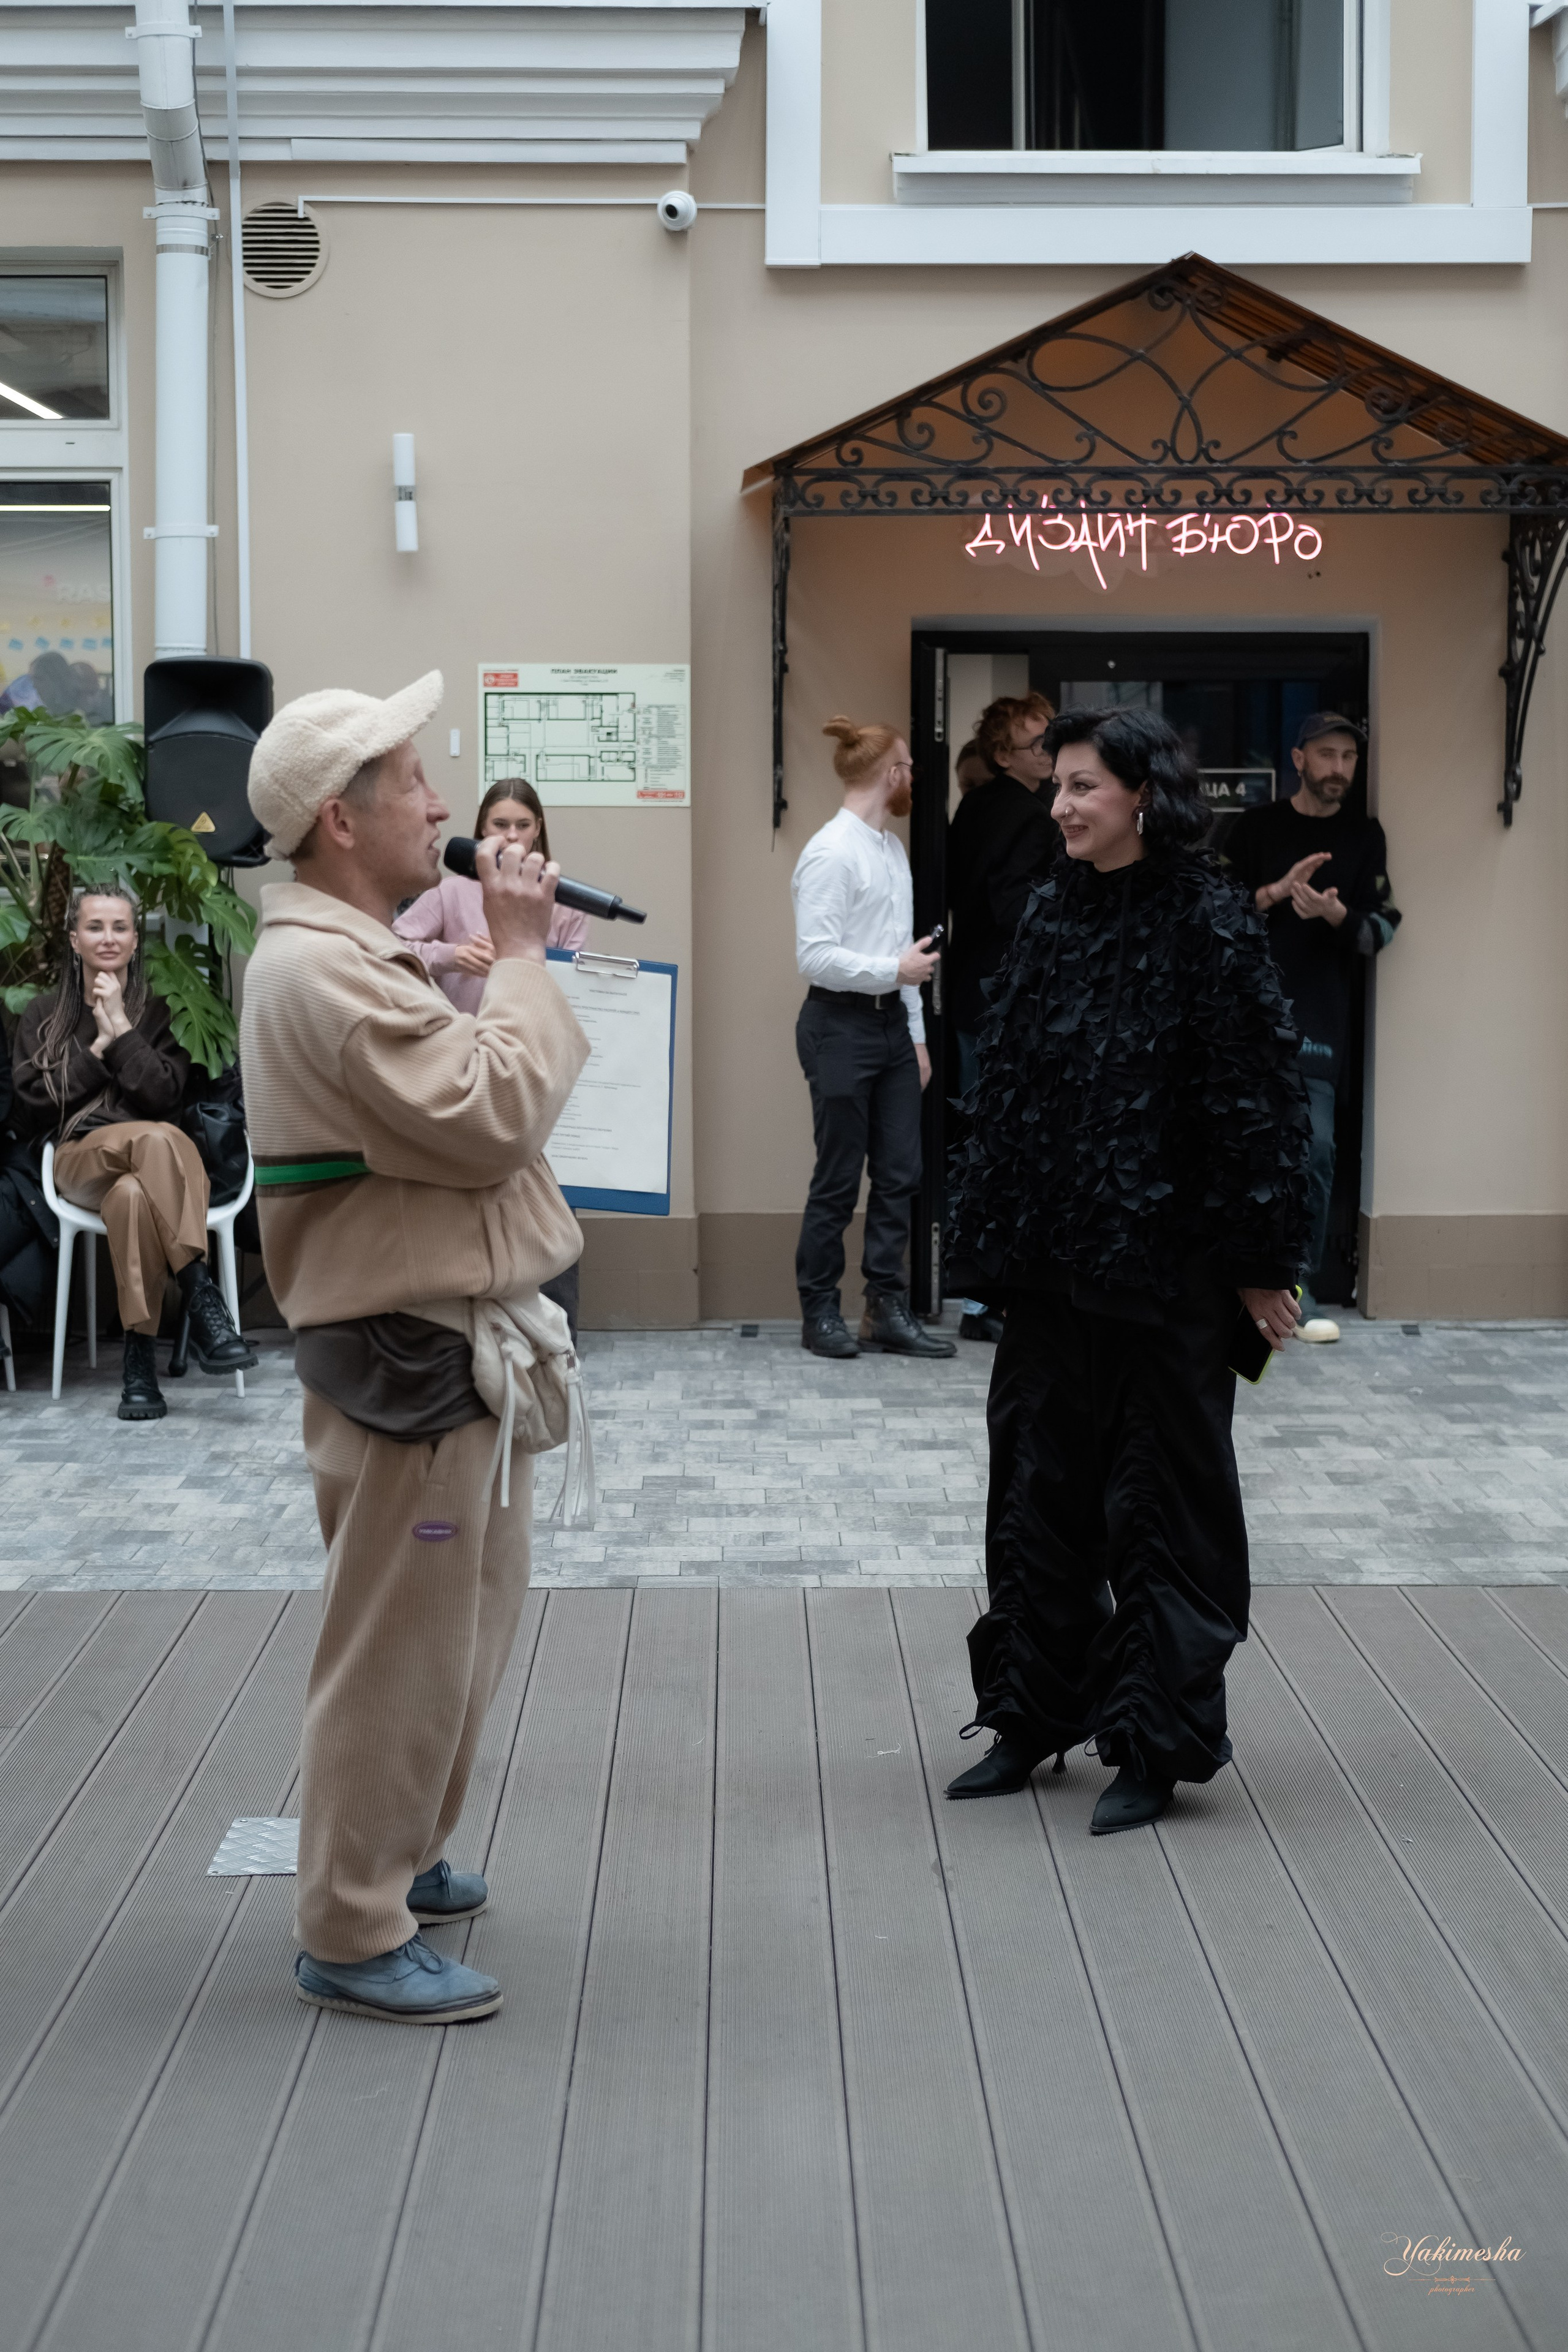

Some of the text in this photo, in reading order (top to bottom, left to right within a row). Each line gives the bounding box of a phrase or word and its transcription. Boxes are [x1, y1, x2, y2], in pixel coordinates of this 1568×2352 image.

[965, 494, 1323, 590] ДИЗАЙН БЮРО
[1235, 782, 1246, 797] 4
